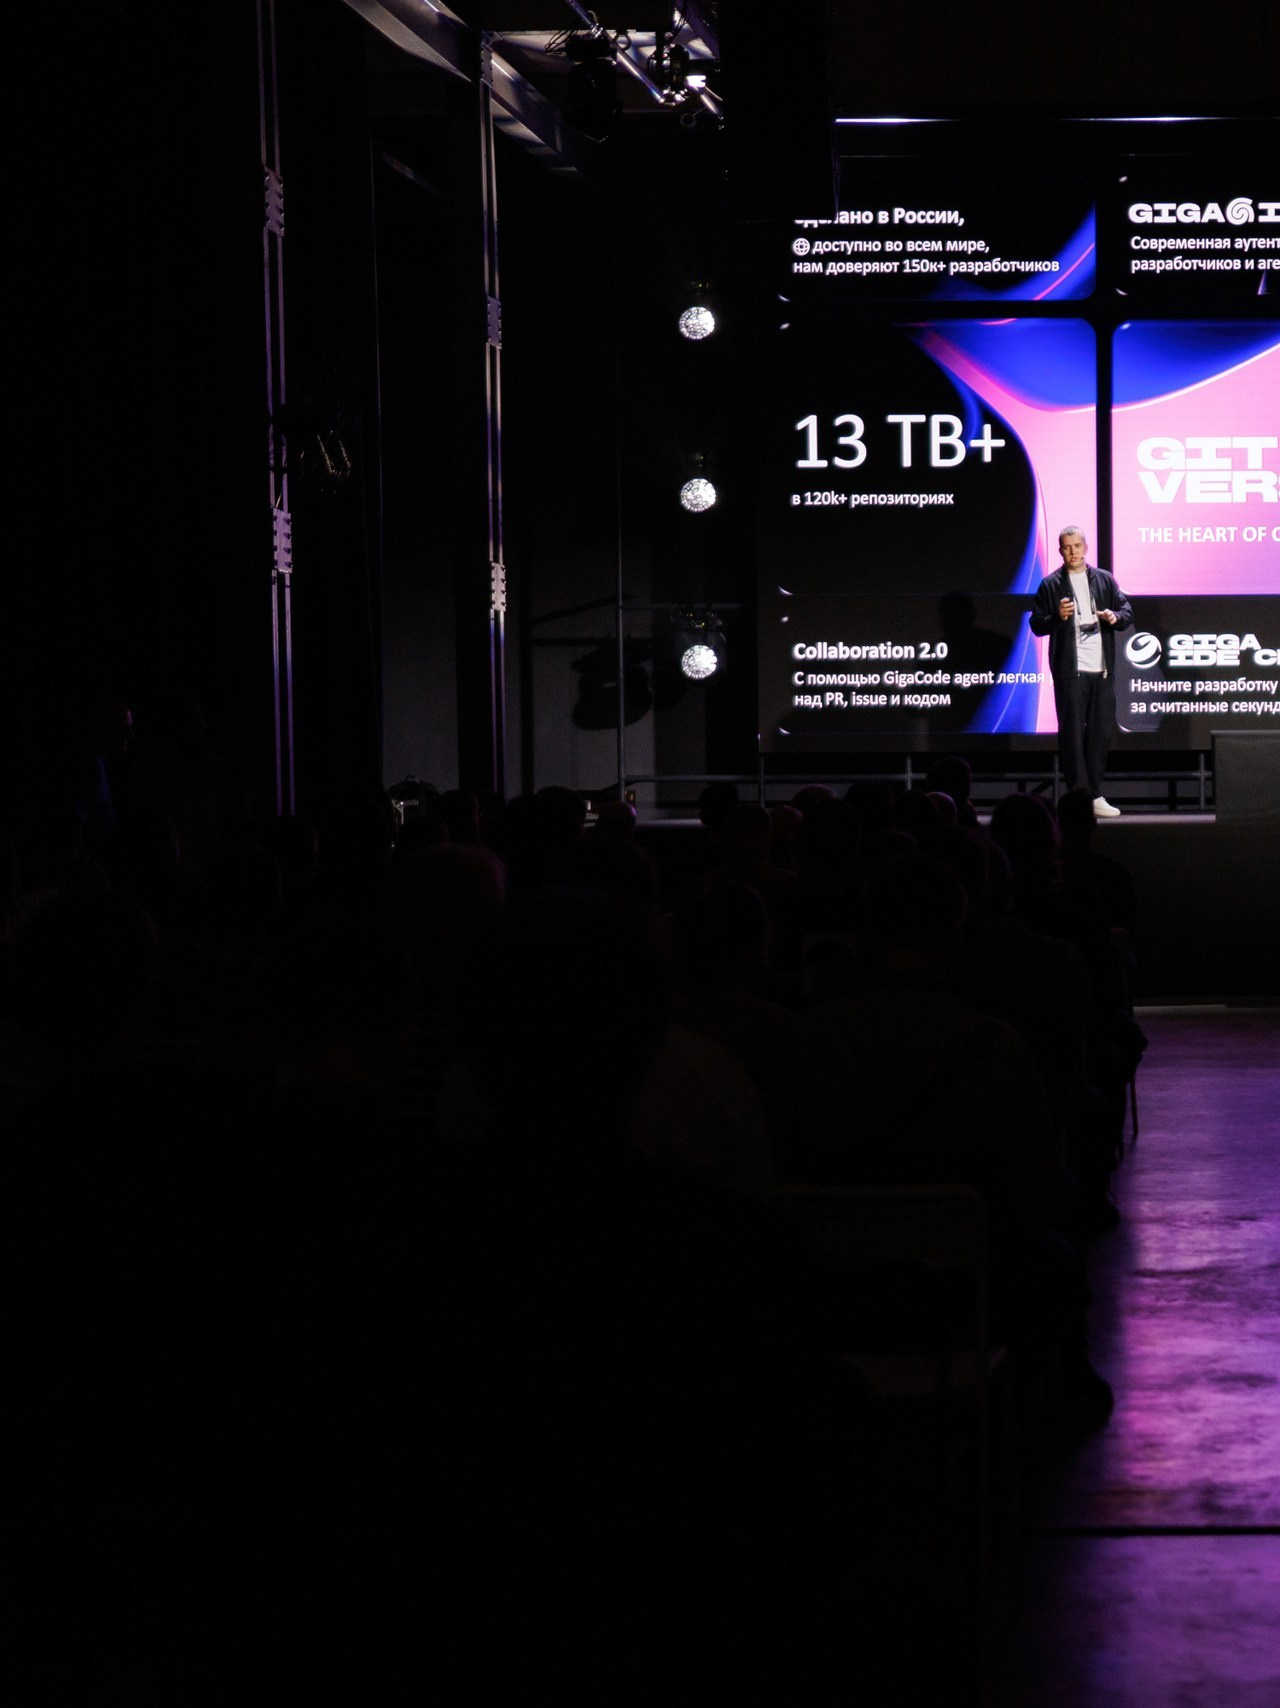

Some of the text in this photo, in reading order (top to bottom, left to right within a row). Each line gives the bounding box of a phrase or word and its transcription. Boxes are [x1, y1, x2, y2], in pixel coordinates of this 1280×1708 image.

[877, 210, 890, 224] в
[894, 208, 964, 226] России,
[1128, 203, 1225, 223] GIGA
[812, 241, 989, 255] доступно во всем мире,
[1131, 236, 1230, 252] Современная
[794, 262, 823, 273] нам
[826, 262, 899, 275] доверяют
[950, 258, 1059, 275] разработчиков
[1132, 256, 1241, 273] разработчиков
[1244, 258, 1255, 270] и
[796, 414, 1006, 468] 13 TB+
[1137, 436, 1278, 470] GIT
[791, 491, 954, 508] в 120k+ репозиториях
[1138, 527, 1173, 542] THE
[1178, 527, 1238, 542] HEART
[1242, 527, 1266, 542] OF
[1169, 633, 1261, 650] GIGA
[793, 642, 948, 659] Collaboration 2.0
[1168, 649, 1240, 666] IDE
[793, 671, 805, 686] С
[808, 674, 880, 687] помощью
[883, 670, 950, 687] GigaCode
[954, 671, 994, 687] agent
[997, 671, 1044, 684] легкая
[1131, 679, 1191, 692] Начните
[1195, 677, 1278, 695] разработку
[794, 692, 951, 708] над PR, issue и кодом
[1131, 702, 1146, 713] за
[1150, 702, 1228, 713] считанные
